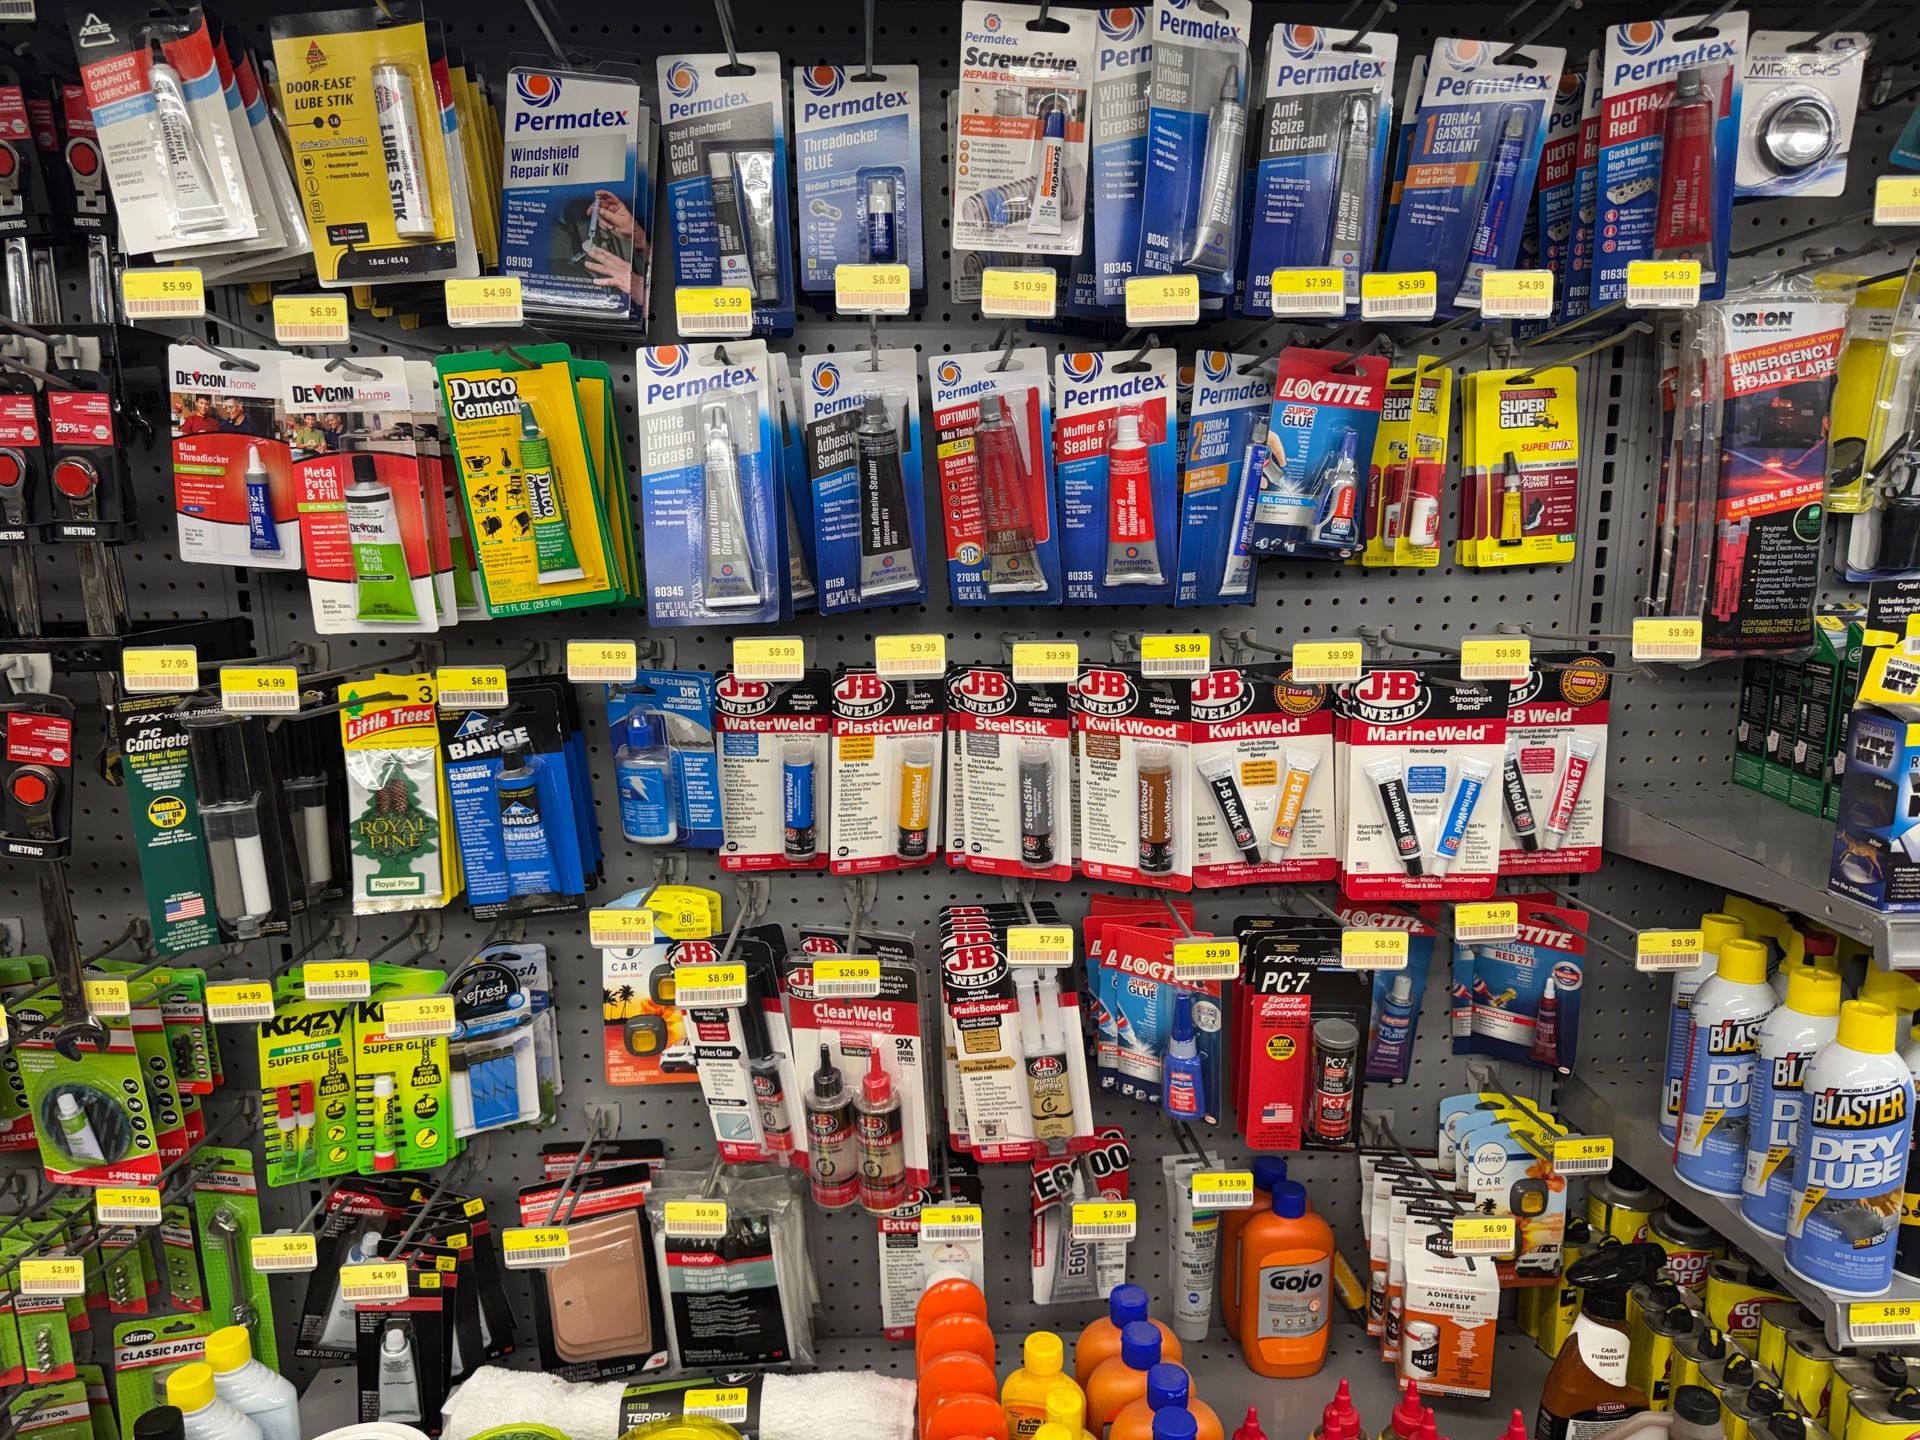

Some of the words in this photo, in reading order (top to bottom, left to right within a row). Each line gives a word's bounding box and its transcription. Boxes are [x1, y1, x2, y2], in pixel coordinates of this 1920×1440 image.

[1157, 47, 1184, 68] White
[88, 57, 136, 78] POWDERED
[1156, 69, 1189, 87] Lithium
[1277, 60, 1386, 87] Permatex
[90, 74, 132, 92] GRAPHITE
[286, 78, 352, 94] DOOR-EASE
[95, 80, 142, 103] LUBRICANT
[1156, 87, 1187, 104] Grease
[294, 96, 323, 109] LUBE
[327, 94, 354, 107] STIK
[1610, 93, 1660, 119] ULTRA
[515, 110, 628, 132] Permatex
[669, 128, 686, 141] Steel
[688, 120, 732, 136] Reinforced
[1271, 119, 1305, 135] Seize
[1608, 117, 1638, 138] Red
[803, 131, 878, 153] Threadlocker
[1269, 133, 1328, 152] Lubricant
[1432, 139, 1480, 154] SEALANT
[511, 145, 579, 162] Windshield
[804, 153, 834, 171] BLUE
[510, 163, 550, 179] Repair
[553, 162, 569, 177] Kit
[1147, 232, 1169, 248] 80345
[506, 256, 533, 268] 09103
[872, 274, 900, 284] $8.99
[1600, 269, 1628, 280] 81630
[1663, 270, 1690, 281] $4.99
[162, 282, 193, 292] $5.99
[1013, 281, 1047, 292] $10.99
[1306, 277, 1332, 287] $7.99
[1398, 280, 1425, 290] $5.99
[1518, 280, 1545, 290] $4.99
[483, 287, 512, 297] $4.99
[1163, 287, 1190, 297] $3.99
[714, 297, 742, 307] $9.99
[310, 307, 338, 317] $6.99
[1731, 312, 1794, 326] ORION
[1730, 343, 1834, 377] EMERGENCY
[176, 370, 228, 390] DEVCON
[230, 378, 256, 391] home
[449, 376, 517, 402] Duco
[1279, 377, 1372, 405] LOCTITE
[1500, 400, 1546, 414] SUPER
[940, 406, 980, 426] OPTIMUM
[1282, 415, 1313, 428] GLUE
[1500, 414, 1535, 428] GLUE
[56, 422, 78, 433] 25%
[1063, 423, 1095, 438] Muffler
[1097, 422, 1106, 432] &
[179, 442, 197, 454] Blue
[1064, 435, 1104, 455] Sealer
[179, 453, 230, 467] Threadlocker
[303, 465, 337, 480] Metal
[305, 477, 338, 492] Patch
[62, 526, 96, 537] METRIC
[1560, 534, 1574, 542] GEL
[957, 573, 980, 583] 27038
[1068, 571, 1093, 581] 80335
[825, 579, 845, 590] 81158
[654, 586, 684, 597] 80345
[1668, 628, 1694, 637] $9.99
[768, 647, 795, 657] $9.99
[1174, 644, 1200, 653] $8.99
[1496, 649, 1521, 658] $9.99
[601, 650, 627, 661] $6.99
[1327, 651, 1353, 660] $9.99
[160, 658, 188, 670] $7.99
[257, 677, 285, 689] $4.99
[471, 675, 498, 686] $6.99
[650, 678, 699, 687] SELF-CLEANING
[1572, 676, 1585, 684] 5020
[1586, 678, 1596, 686] PSI
[419, 686, 432, 703] 3
[680, 688, 700, 698] DRY
[390, 708, 431, 726] Trees
[347, 717, 387, 740] Little
[723, 718, 816, 732] WaterWeld
[837, 718, 934, 733] PlasticWeld
[976, 718, 1048, 734] SteelStik
[1085, 716, 1177, 738] KwikWood
[1209, 719, 1300, 738] KwikWeld
[1366, 726, 1486, 742] MarineWeld
[126, 736, 189, 753] Concrete
[448, 726, 531, 760] BARGE
[1875, 780, 1892, 790] Before
[153, 802, 181, 812] WORKS
[360, 818, 430, 835] ROYAL
[370, 832, 422, 849] PINE
[1868, 838, 1883, 848] After
[9, 844, 44, 856] METRIC
[374, 880, 395, 889] Royal
[398, 879, 415, 888] Pine
[1487, 910, 1510, 919] $4.99
[622, 917, 646, 925] $7.99
[1040, 936, 1065, 944] $7.99
[1374, 940, 1400, 948] $8.99
[1670, 937, 1696, 948] $9.99
[1206, 950, 1230, 958] $9.99
[1495, 951, 1515, 962] RED
[1516, 955, 1534, 966] 271
[335, 969, 359, 978] $3.99
[708, 973, 735, 982] $8.99
[839, 967, 870, 977] $26.99
[94, 987, 120, 996] $1.99
[237, 991, 261, 1000] $4.99
[162, 1006, 183, 1014] VALVE
[184, 1006, 200, 1014] CAPS
[419, 1004, 446, 1014] $3.99
[813, 1003, 893, 1022] ClearWeld
[18, 1011, 44, 1023] slime
[816, 1018, 854, 1026] Professional
[284, 1044, 302, 1054] MAX
[305, 1041, 327, 1051] BOND
[896, 1038, 913, 1049] 9X
[699, 1048, 716, 1057] Dries
[717, 1049, 733, 1057] Clear
[1813, 1130, 1854, 1138] ADVANCED
[1582, 1146, 1606, 1154] $8.99
[1810, 1129, 1906, 1161] DRY
[1474, 1152, 1504, 1164] febreze
[109, 1172, 141, 1181] 5-PIECE
[142, 1173, 158, 1182] KIT
[1807, 1155, 1903, 1190] LUBE
[1218, 1180, 1247, 1188] $13.99
[122, 1196, 151, 1205] $17.99
[696, 1209, 719, 1218] $9.99
[952, 1214, 975, 1223] $9.99
[1103, 1210, 1127, 1219] $7.99
[1483, 1224, 1508, 1233] $6.99
[534, 1234, 559, 1244] $5.99
[1853, 1238, 1870, 1248] SINCE
[1871, 1233, 1886, 1246] 1957
[681, 1254, 714, 1263] bondo
[52, 1266, 75, 1274] $2.99
[371, 1271, 397, 1280] $4.99
[1270, 1273, 1323, 1292] GOJO
[1427, 1290, 1477, 1302] ADHESIVE
[1883, 1306, 1911, 1317] $8.99
[120, 1346, 165, 1363] CLASSIC
[1596, 1403, 1626, 1413] WEIMAN
